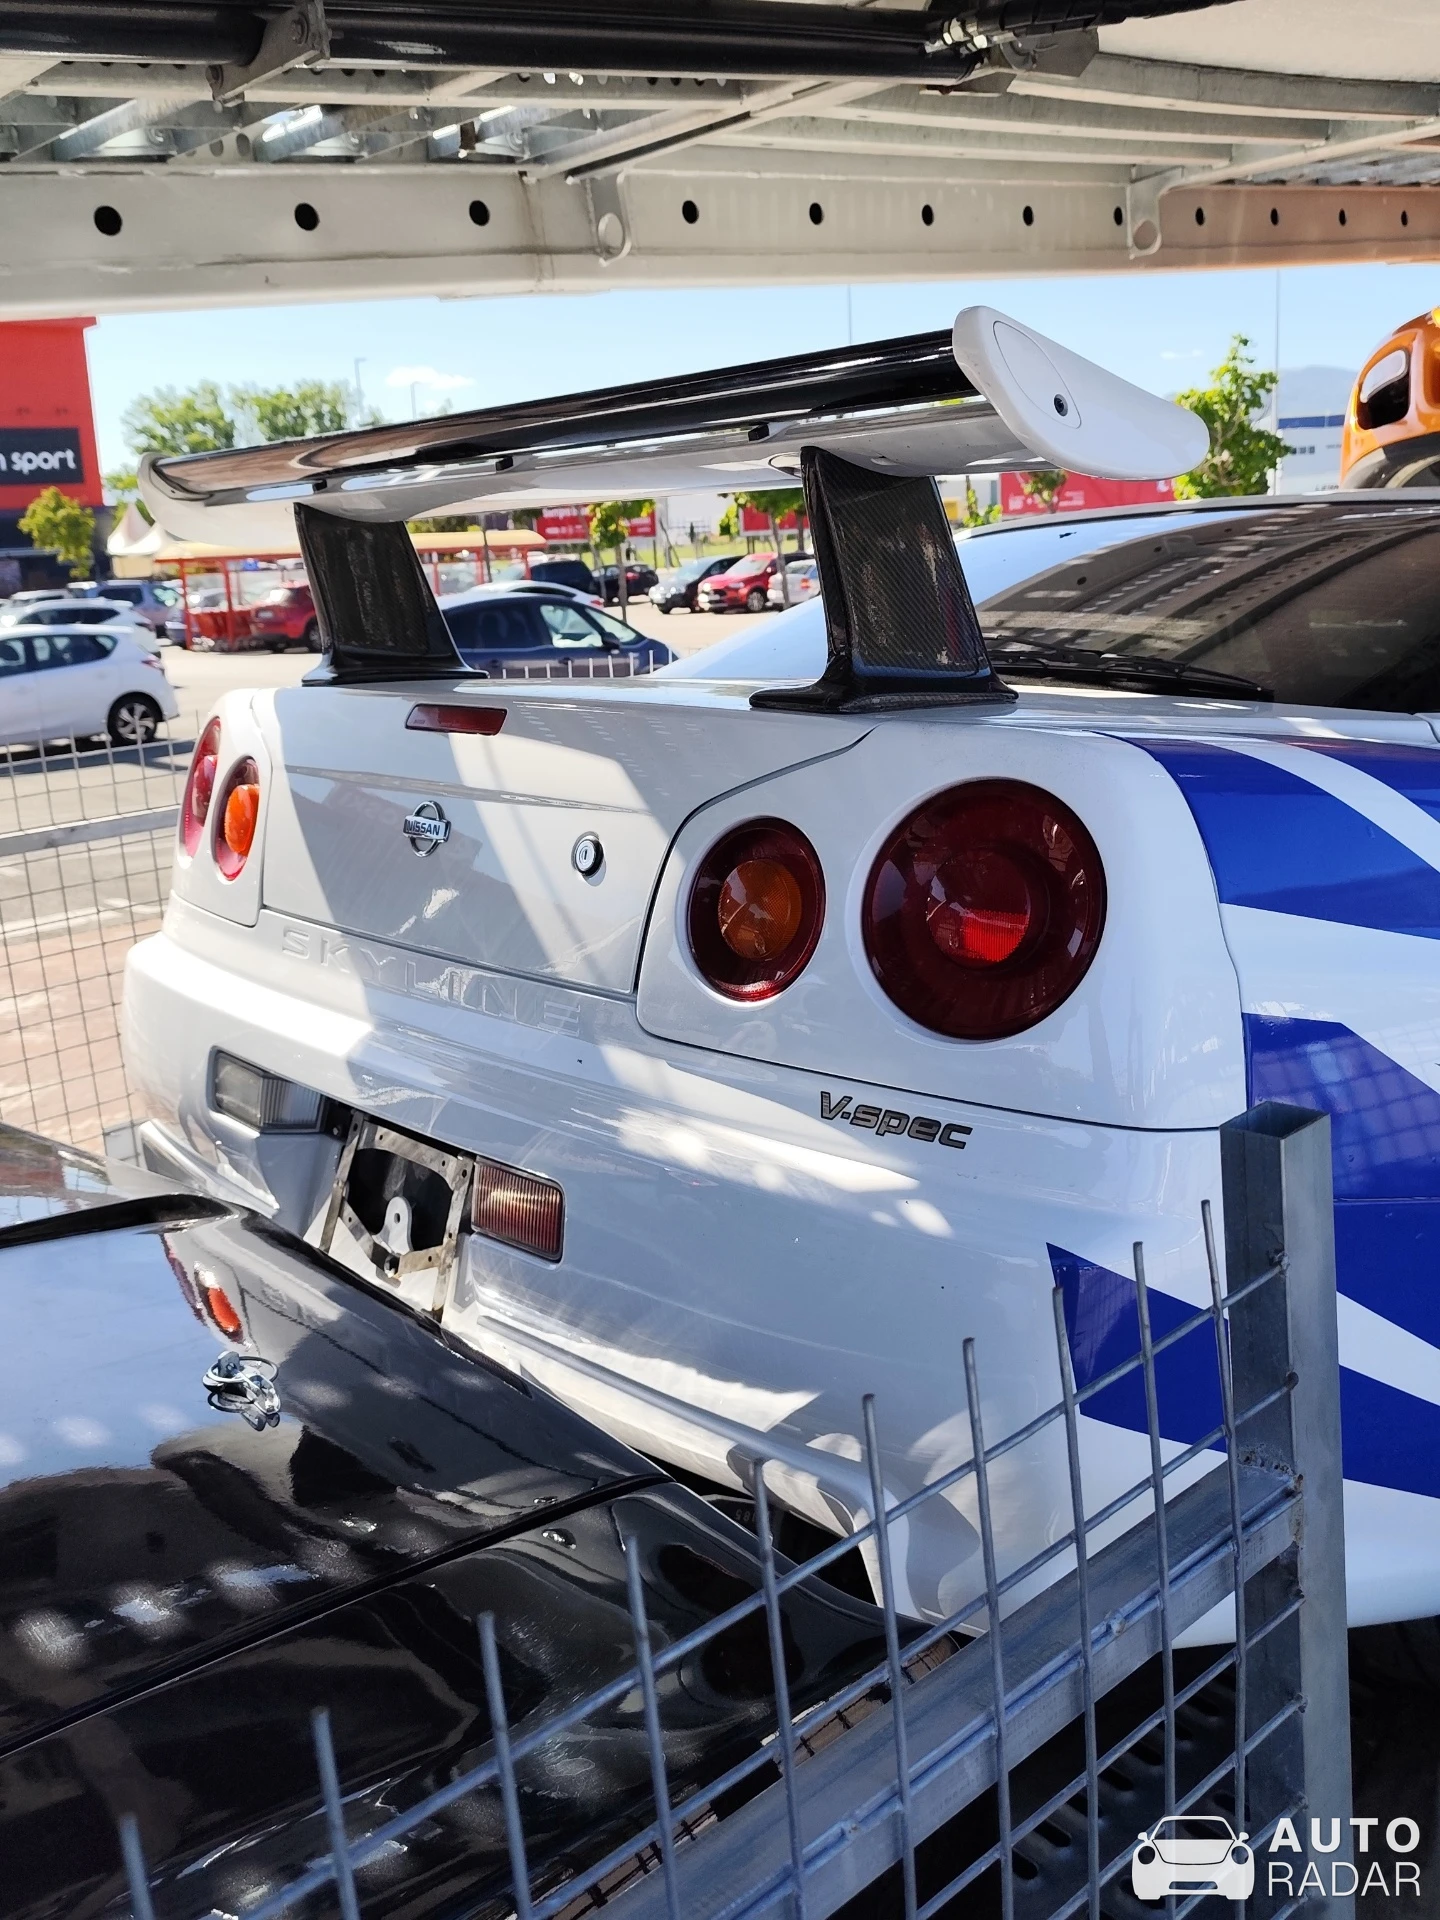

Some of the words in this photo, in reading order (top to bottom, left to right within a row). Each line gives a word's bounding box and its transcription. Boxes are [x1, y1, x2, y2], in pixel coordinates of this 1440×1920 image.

[11, 449, 76, 475] sport
[406, 819, 440, 836] NISSAN
[282, 928, 581, 1037] SKYLINE
